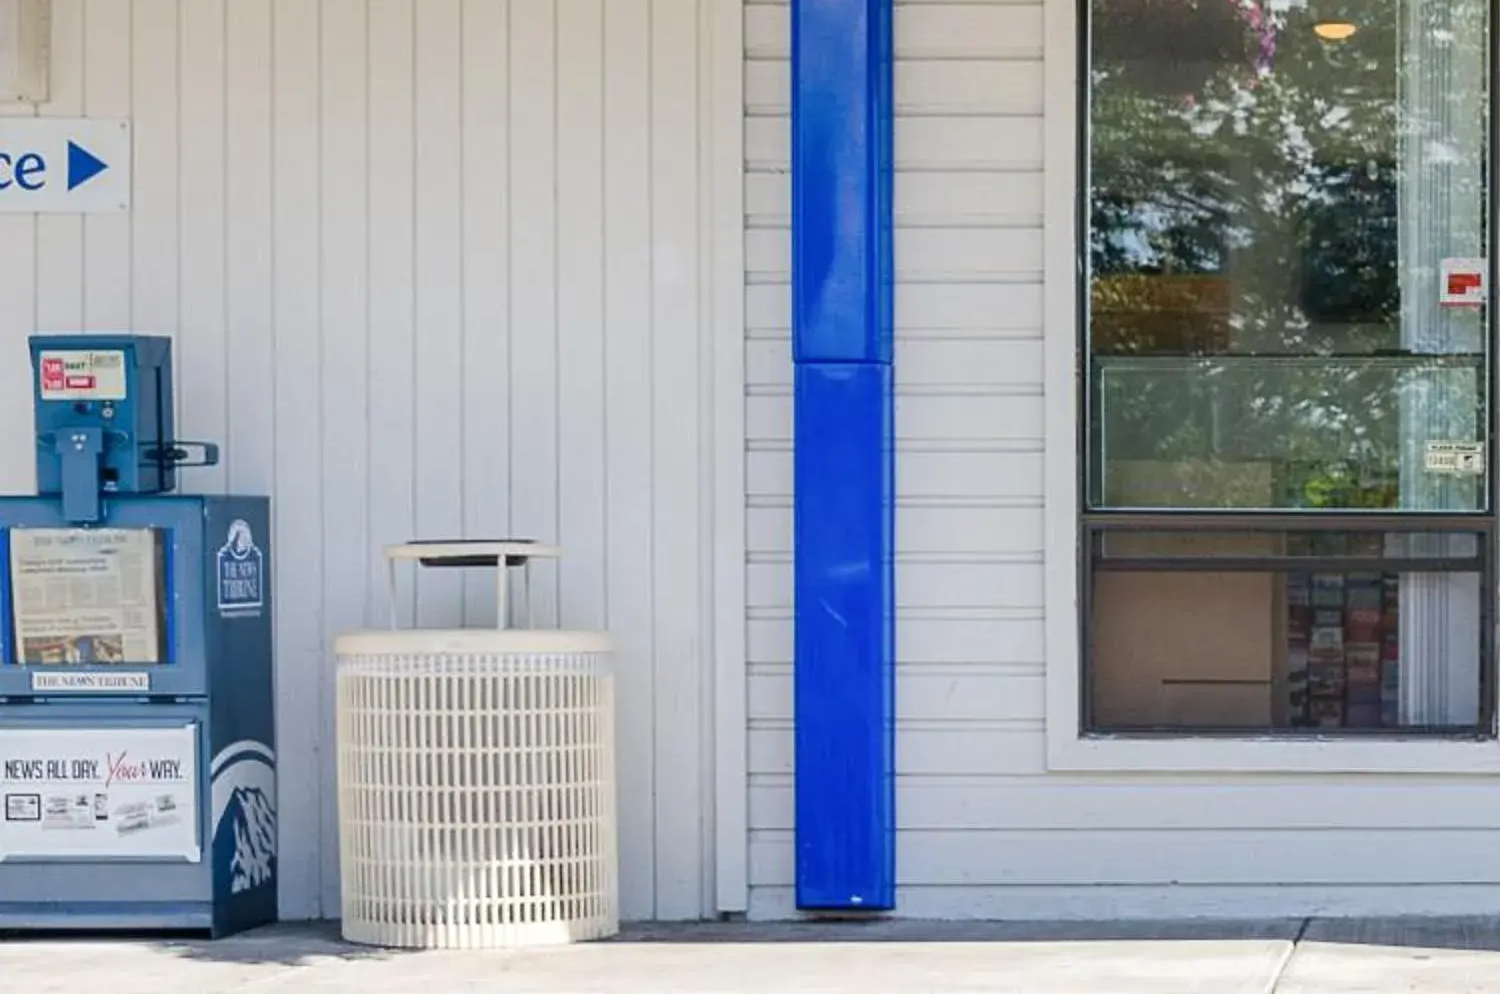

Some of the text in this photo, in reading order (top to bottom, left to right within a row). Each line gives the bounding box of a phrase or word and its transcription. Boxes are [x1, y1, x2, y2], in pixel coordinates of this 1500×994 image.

[5, 760, 43, 779] NEWS
[47, 760, 69, 779] ALL
[72, 760, 101, 779] DAY.
[149, 760, 183, 779] WAY.
